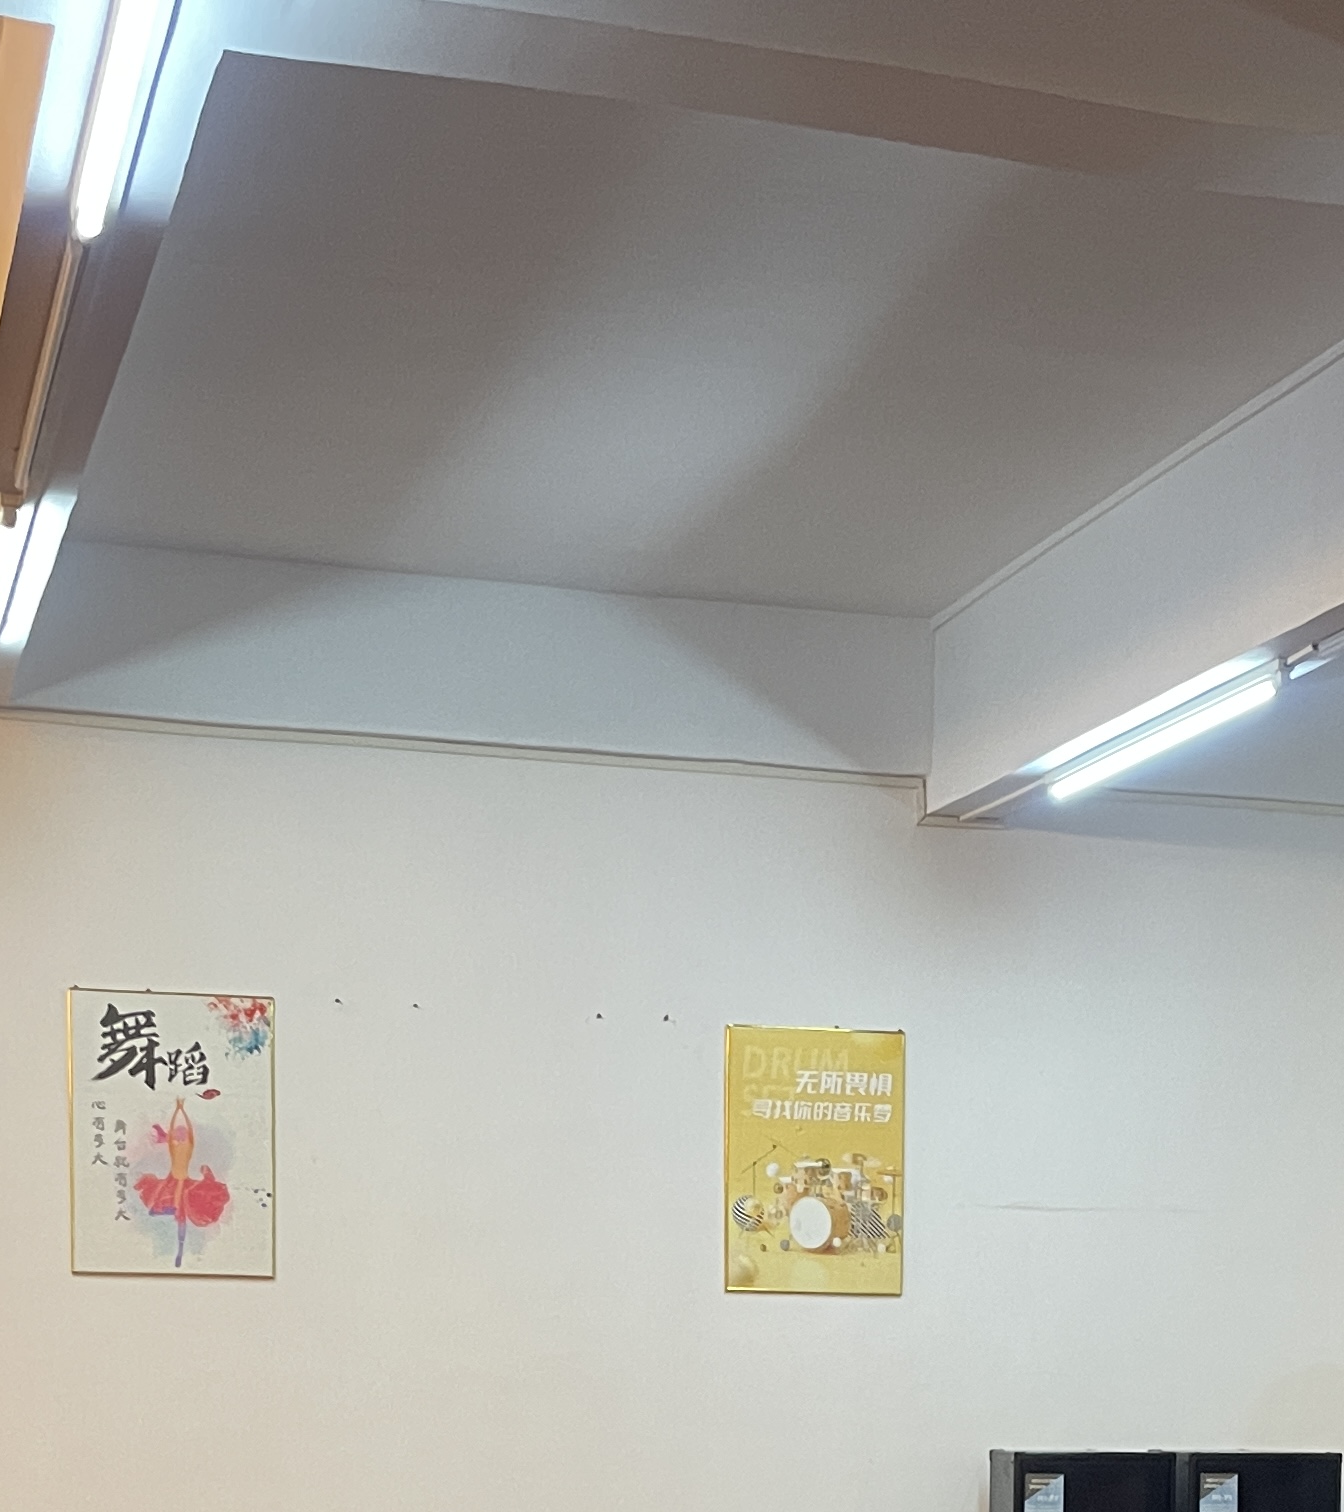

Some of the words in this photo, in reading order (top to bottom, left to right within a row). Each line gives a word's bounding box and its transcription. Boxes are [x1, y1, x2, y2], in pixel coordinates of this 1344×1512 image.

[91, 1003, 210, 1090] 舞蹈
[795, 1069, 893, 1097] 无所畏惧
